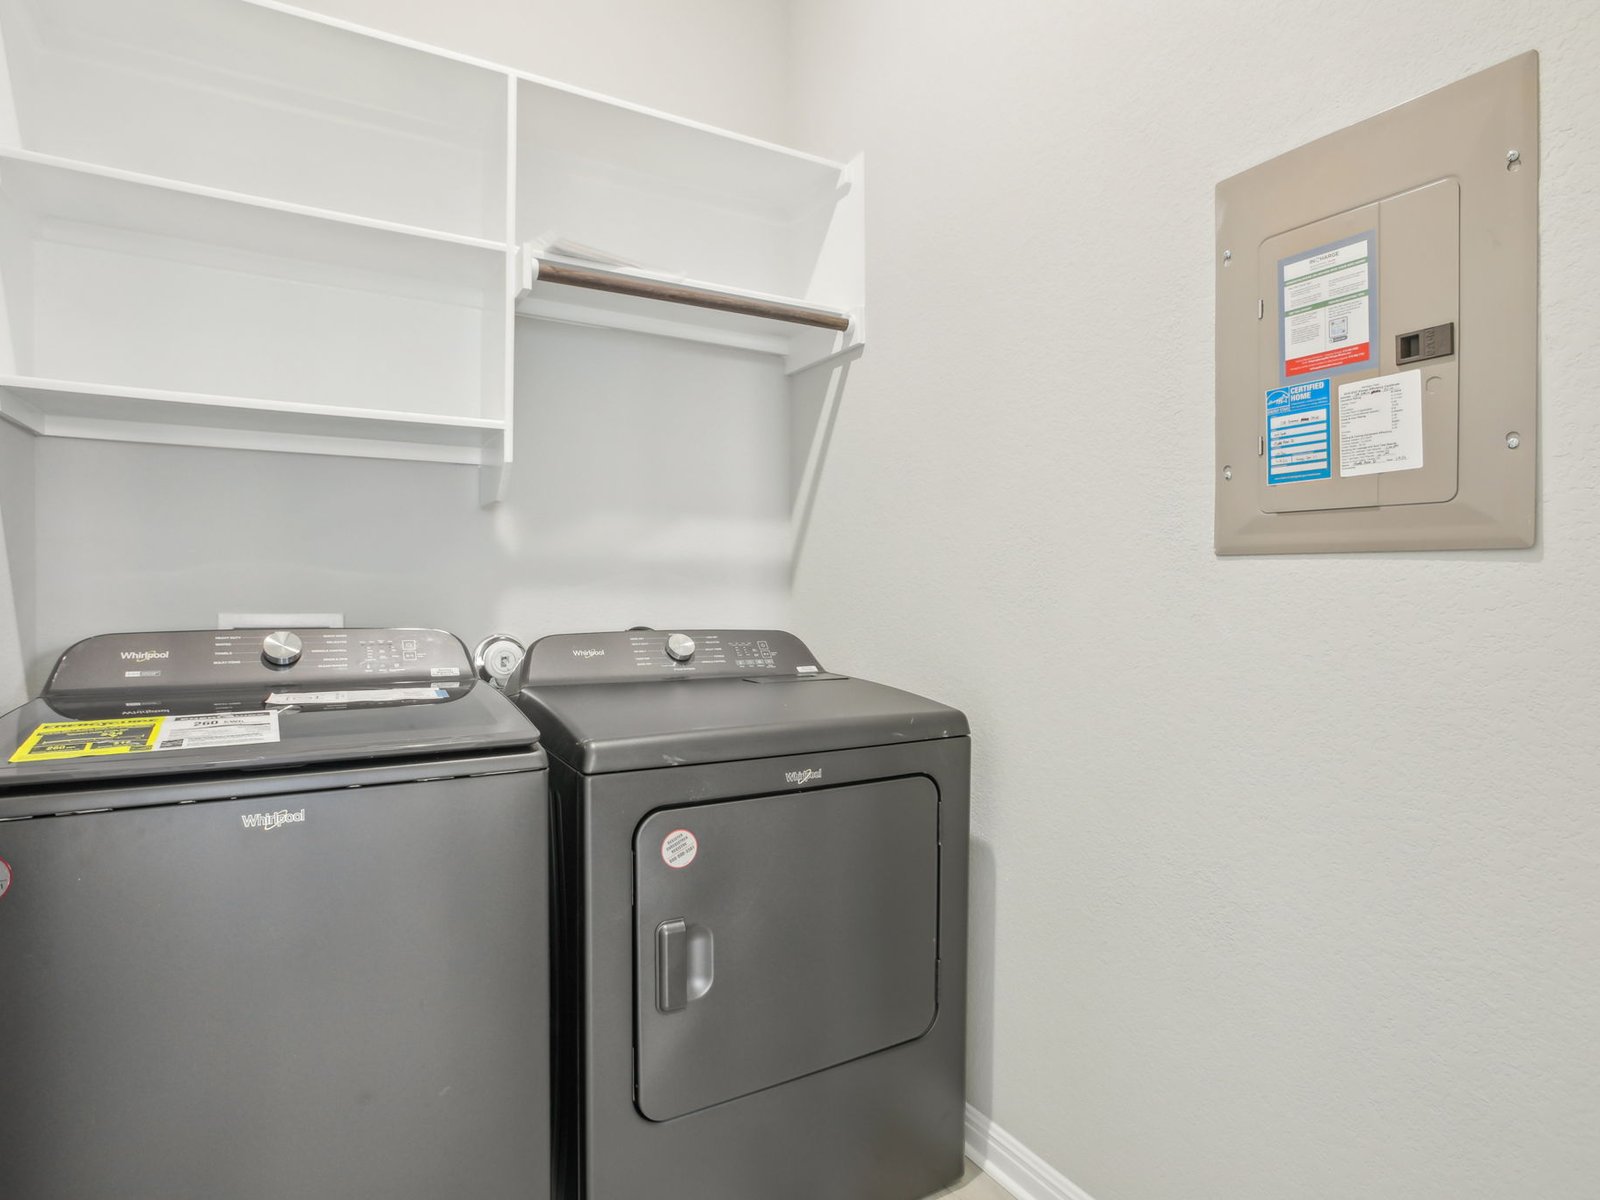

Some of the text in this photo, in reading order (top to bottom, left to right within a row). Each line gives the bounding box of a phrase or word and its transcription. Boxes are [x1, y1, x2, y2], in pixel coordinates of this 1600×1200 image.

[1290, 381, 1325, 395] CERTIFIED
[1290, 391, 1312, 402] HOME
[120, 649, 170, 663] Whirlpool
[572, 648, 605, 659] Whirlpool
[193, 719, 219, 727] 260
[785, 768, 822, 785] Whirlpool
[241, 808, 305, 831] Whirlpool
